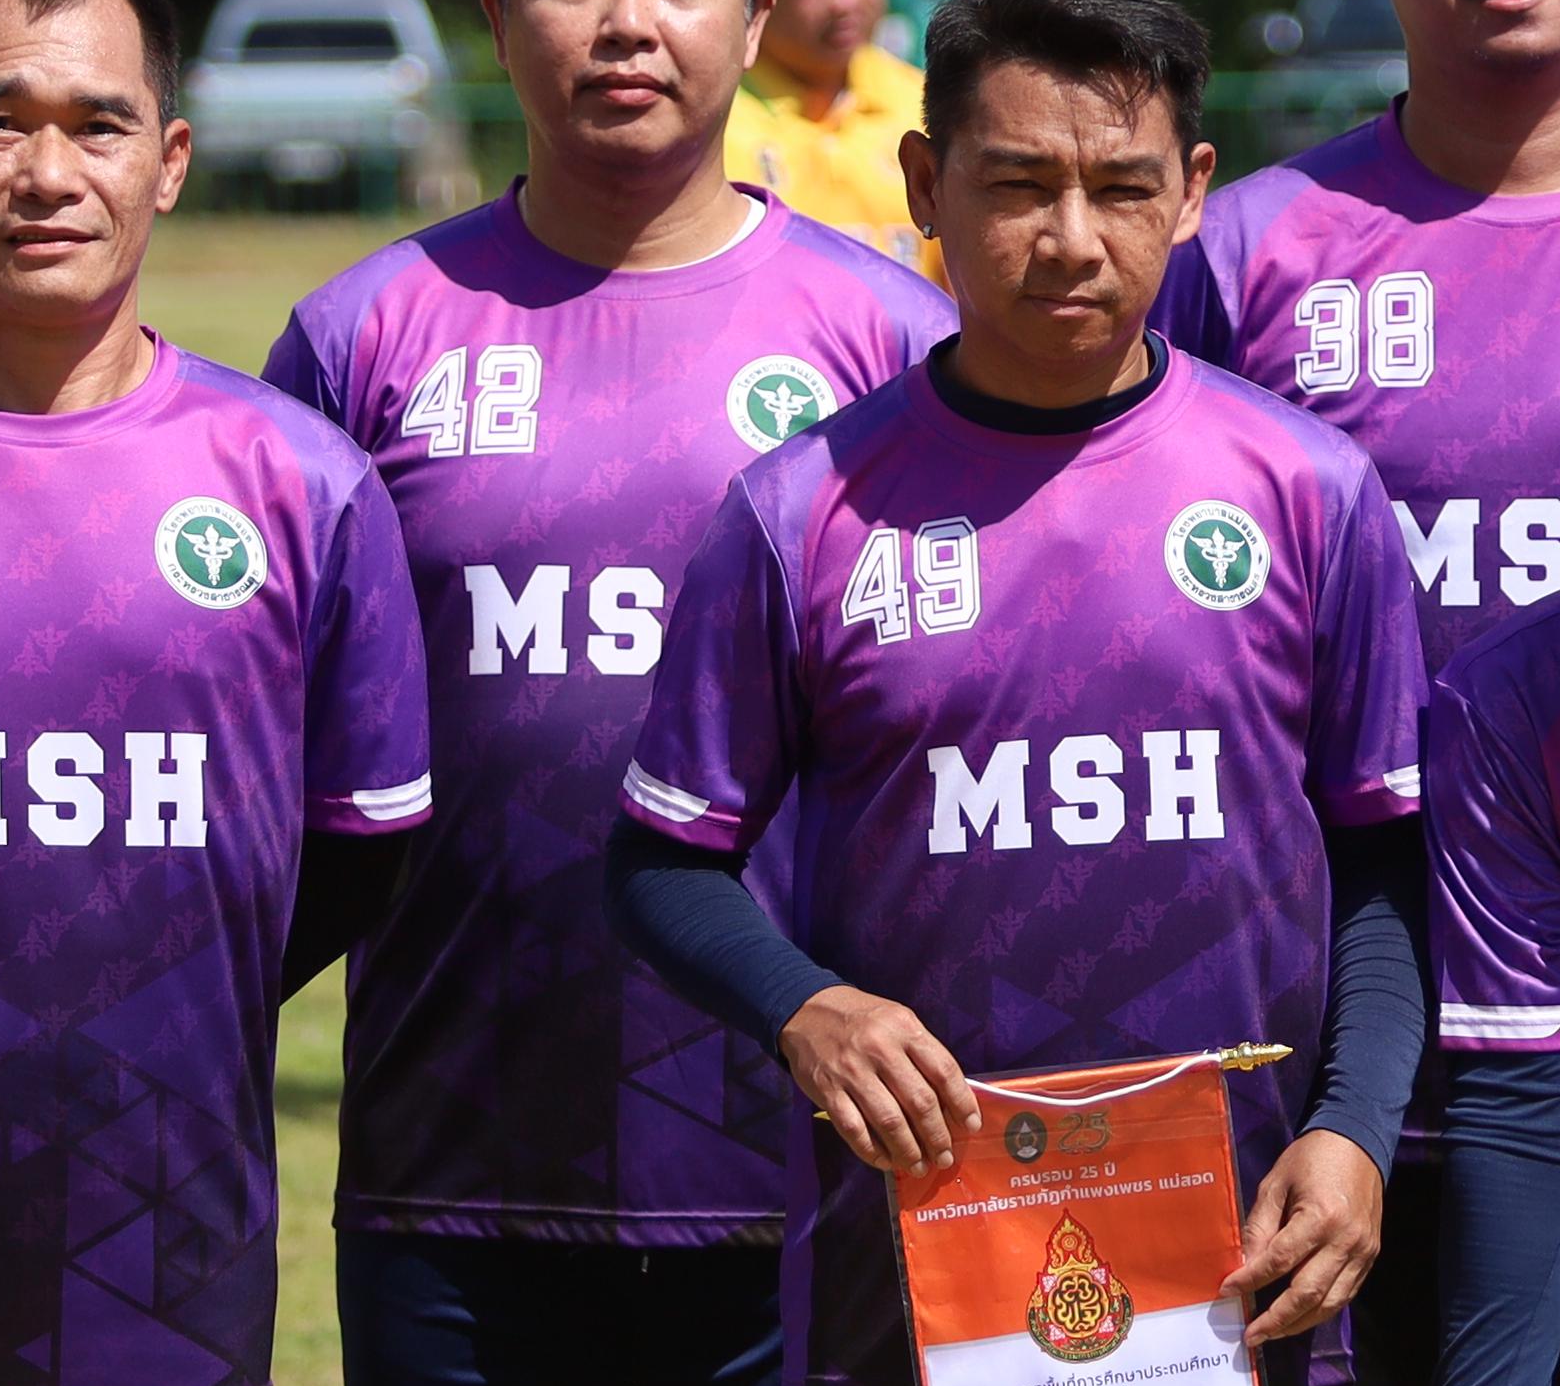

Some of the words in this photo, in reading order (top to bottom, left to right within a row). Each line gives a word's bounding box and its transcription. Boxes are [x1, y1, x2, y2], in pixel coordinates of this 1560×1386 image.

[1294, 270, 1434, 395] 38
[401, 344, 542, 459] 42
[464, 565, 665, 676] MS
[841, 515, 982, 646] 49
[927, 729, 1225, 855] MSH
[916, 1179, 1153, 1223] มหาวิทยาลัยราชภัฏกำแพงเพชร
[1158, 1169, 1214, 1190] แม่สอด
[1010, 1169, 1073, 1189] ครบรอบ
[1080, 1165, 1099, 1180] 25
[1104, 1160, 1116, 1178] ปี
